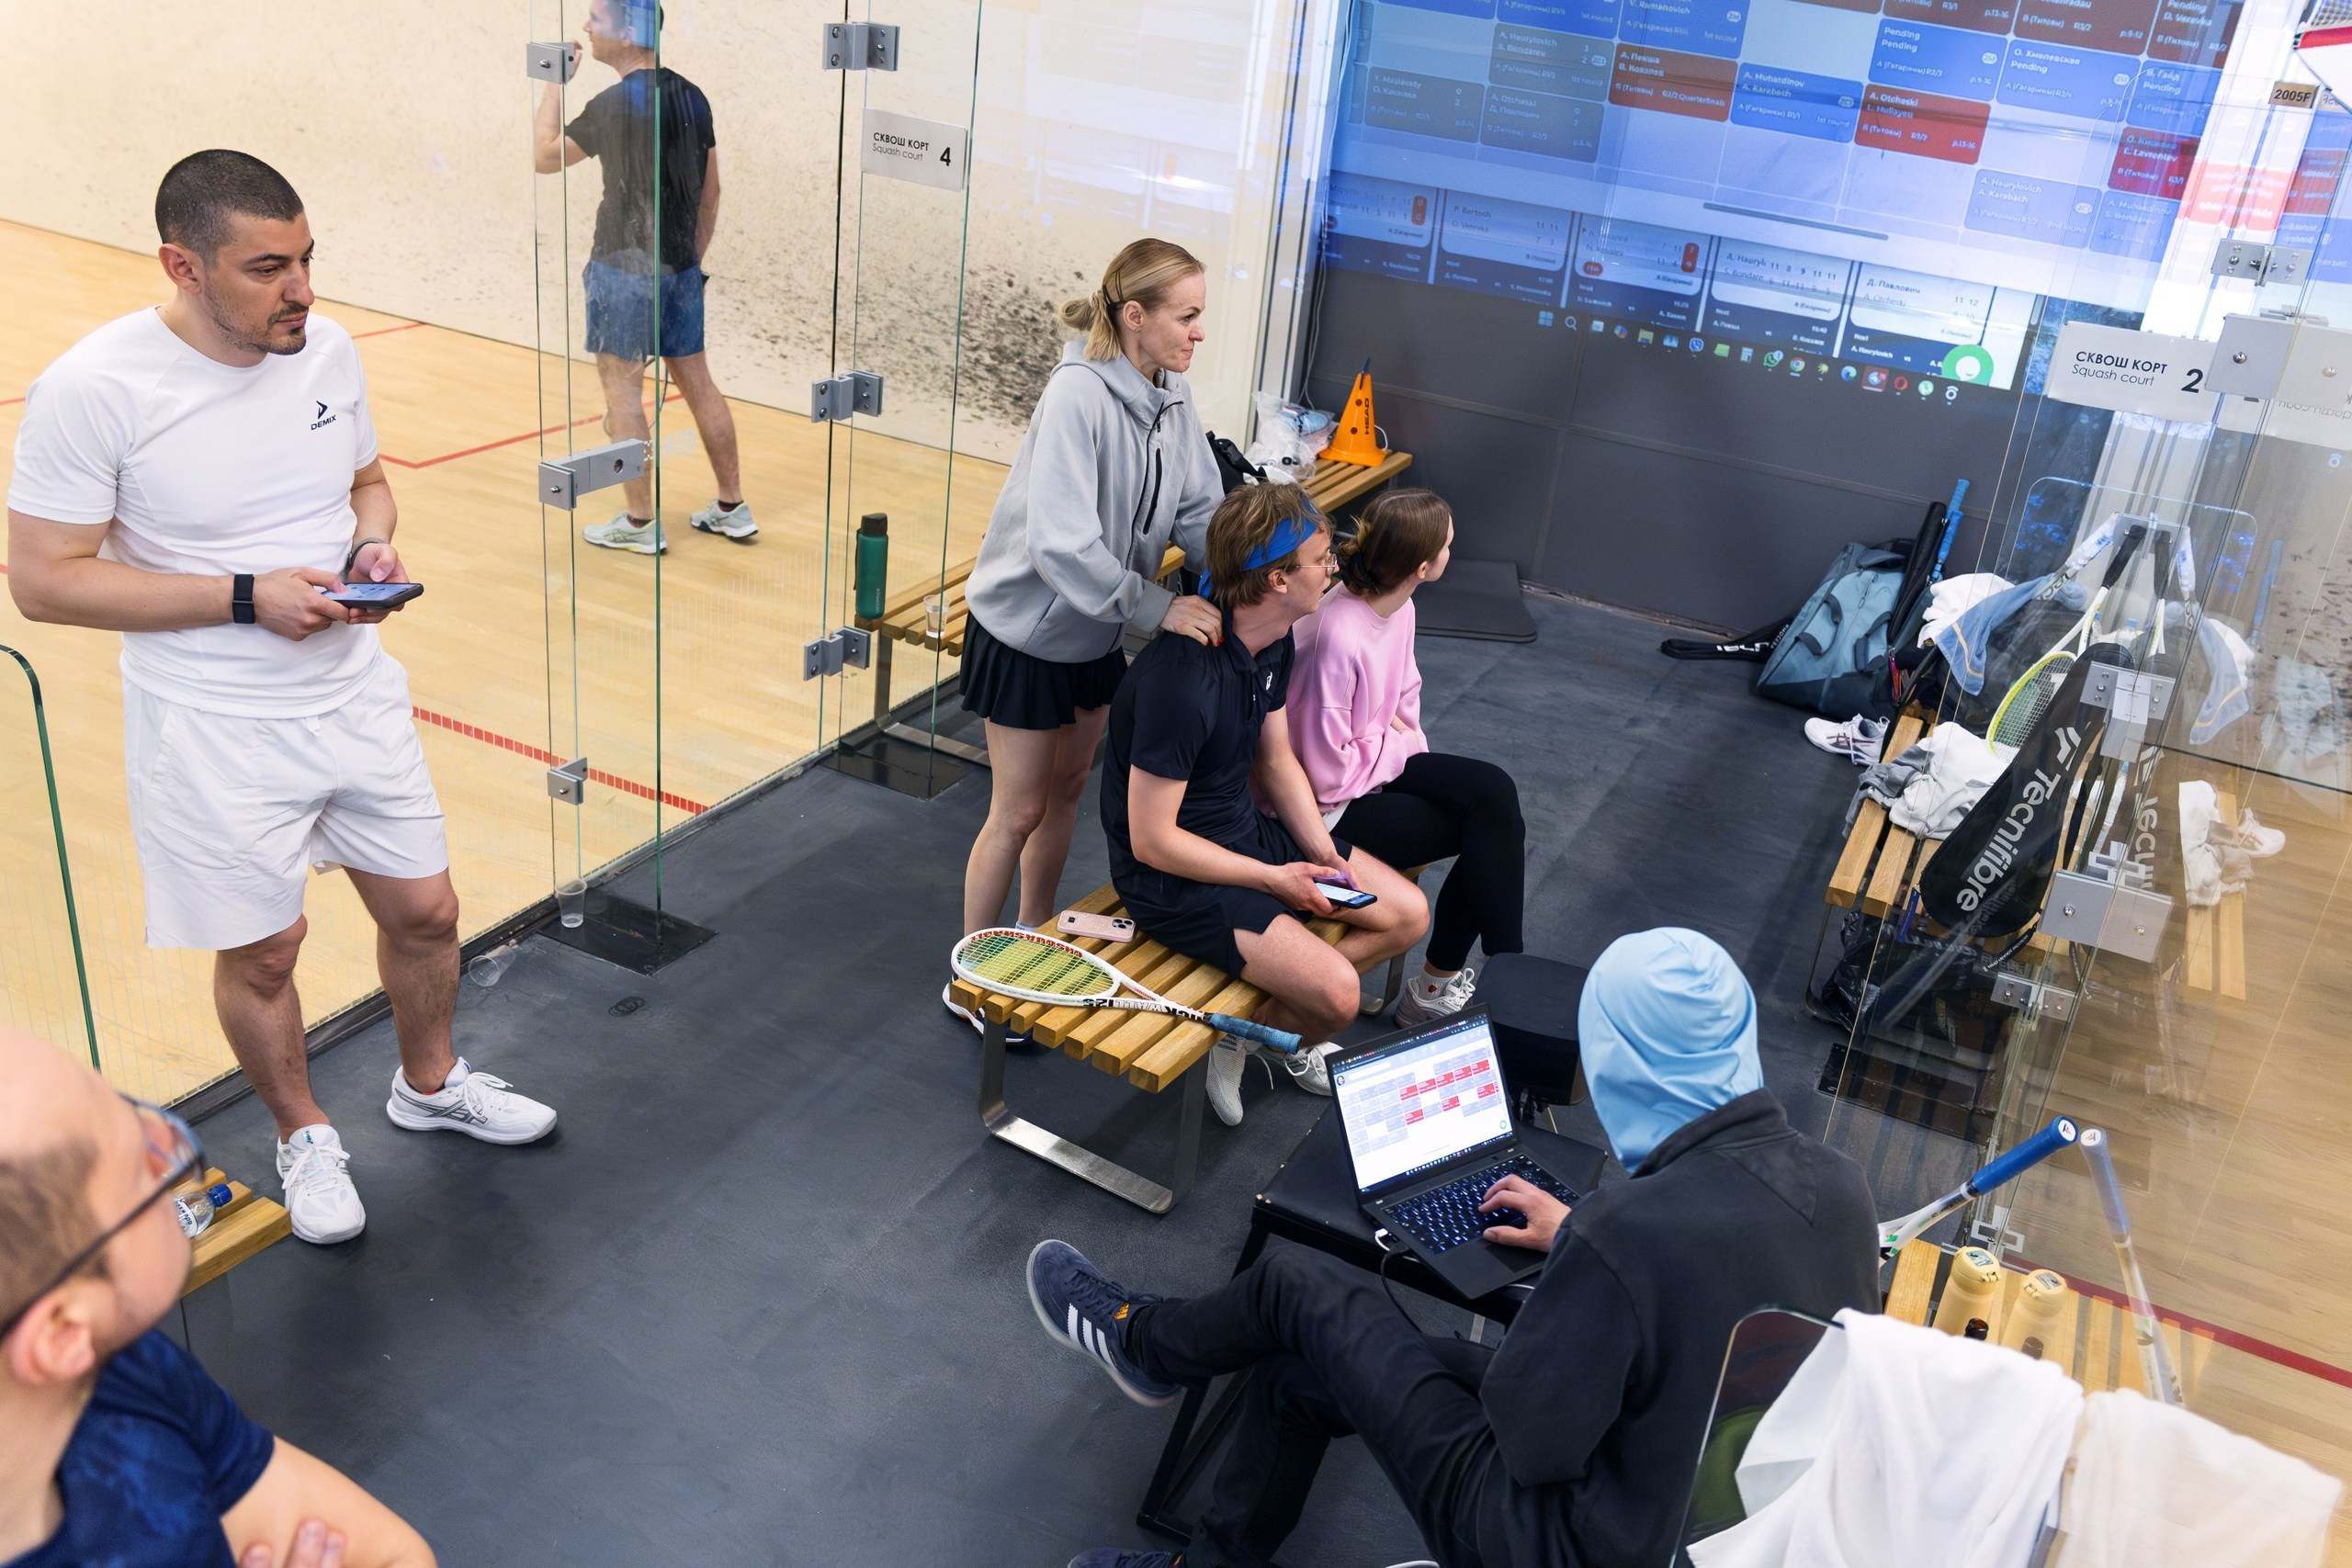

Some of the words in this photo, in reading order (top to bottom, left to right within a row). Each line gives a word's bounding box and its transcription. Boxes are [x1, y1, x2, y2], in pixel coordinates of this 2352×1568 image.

[1884, 26, 1921, 40] Pending
[1882, 39, 1918, 53] Pending
[2010, 61, 2049, 75] Pending
[2143, 82, 2182, 96] Pending
[2273, 88, 2312, 105] 2005F
[1880, 93, 1919, 107] Otcheski
[873, 131, 906, 147] СКВОШ
[908, 139, 930, 152] КОРТ
[872, 142, 901, 157] Squash
[902, 150, 923, 161] court
[939, 146, 952, 167] 4
[1992, 178, 2042, 195] Haurylovich
[1988, 190, 2029, 204] Karabach
[1878, 280, 1921, 294] Павлович
[2075, 350, 2131, 369] СКВОШ
[2131, 358, 2168, 375] КОРТ
[2071, 363, 2118, 382] Squash
[2120, 373, 2155, 387] court
[2180, 368, 2205, 394] 2
[310, 414, 337, 431] DEMIX
[1956, 768, 2062, 911] Tecnifibre
